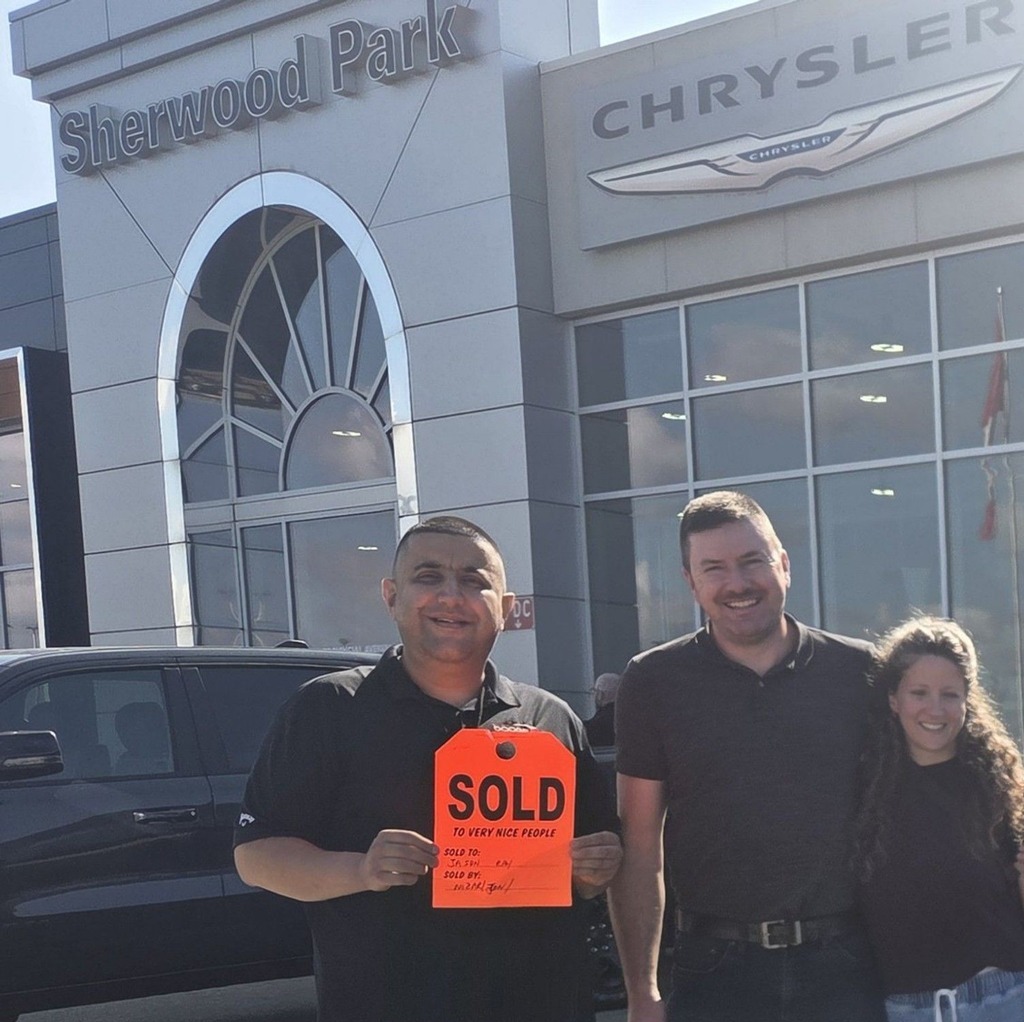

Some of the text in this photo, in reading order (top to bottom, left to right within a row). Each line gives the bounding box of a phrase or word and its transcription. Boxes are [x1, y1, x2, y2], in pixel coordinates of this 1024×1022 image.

[593, 0, 1017, 140] CHRYSLER
[58, 0, 461, 175] Sherwood Park
[749, 136, 831, 161] CHRYSLER
[448, 773, 566, 821] SOLD
[453, 827, 557, 838] TO VERY NICE PEOPLE
[443, 848, 481, 857] SOLD TO:
[443, 870, 482, 879] SOLD BY:
